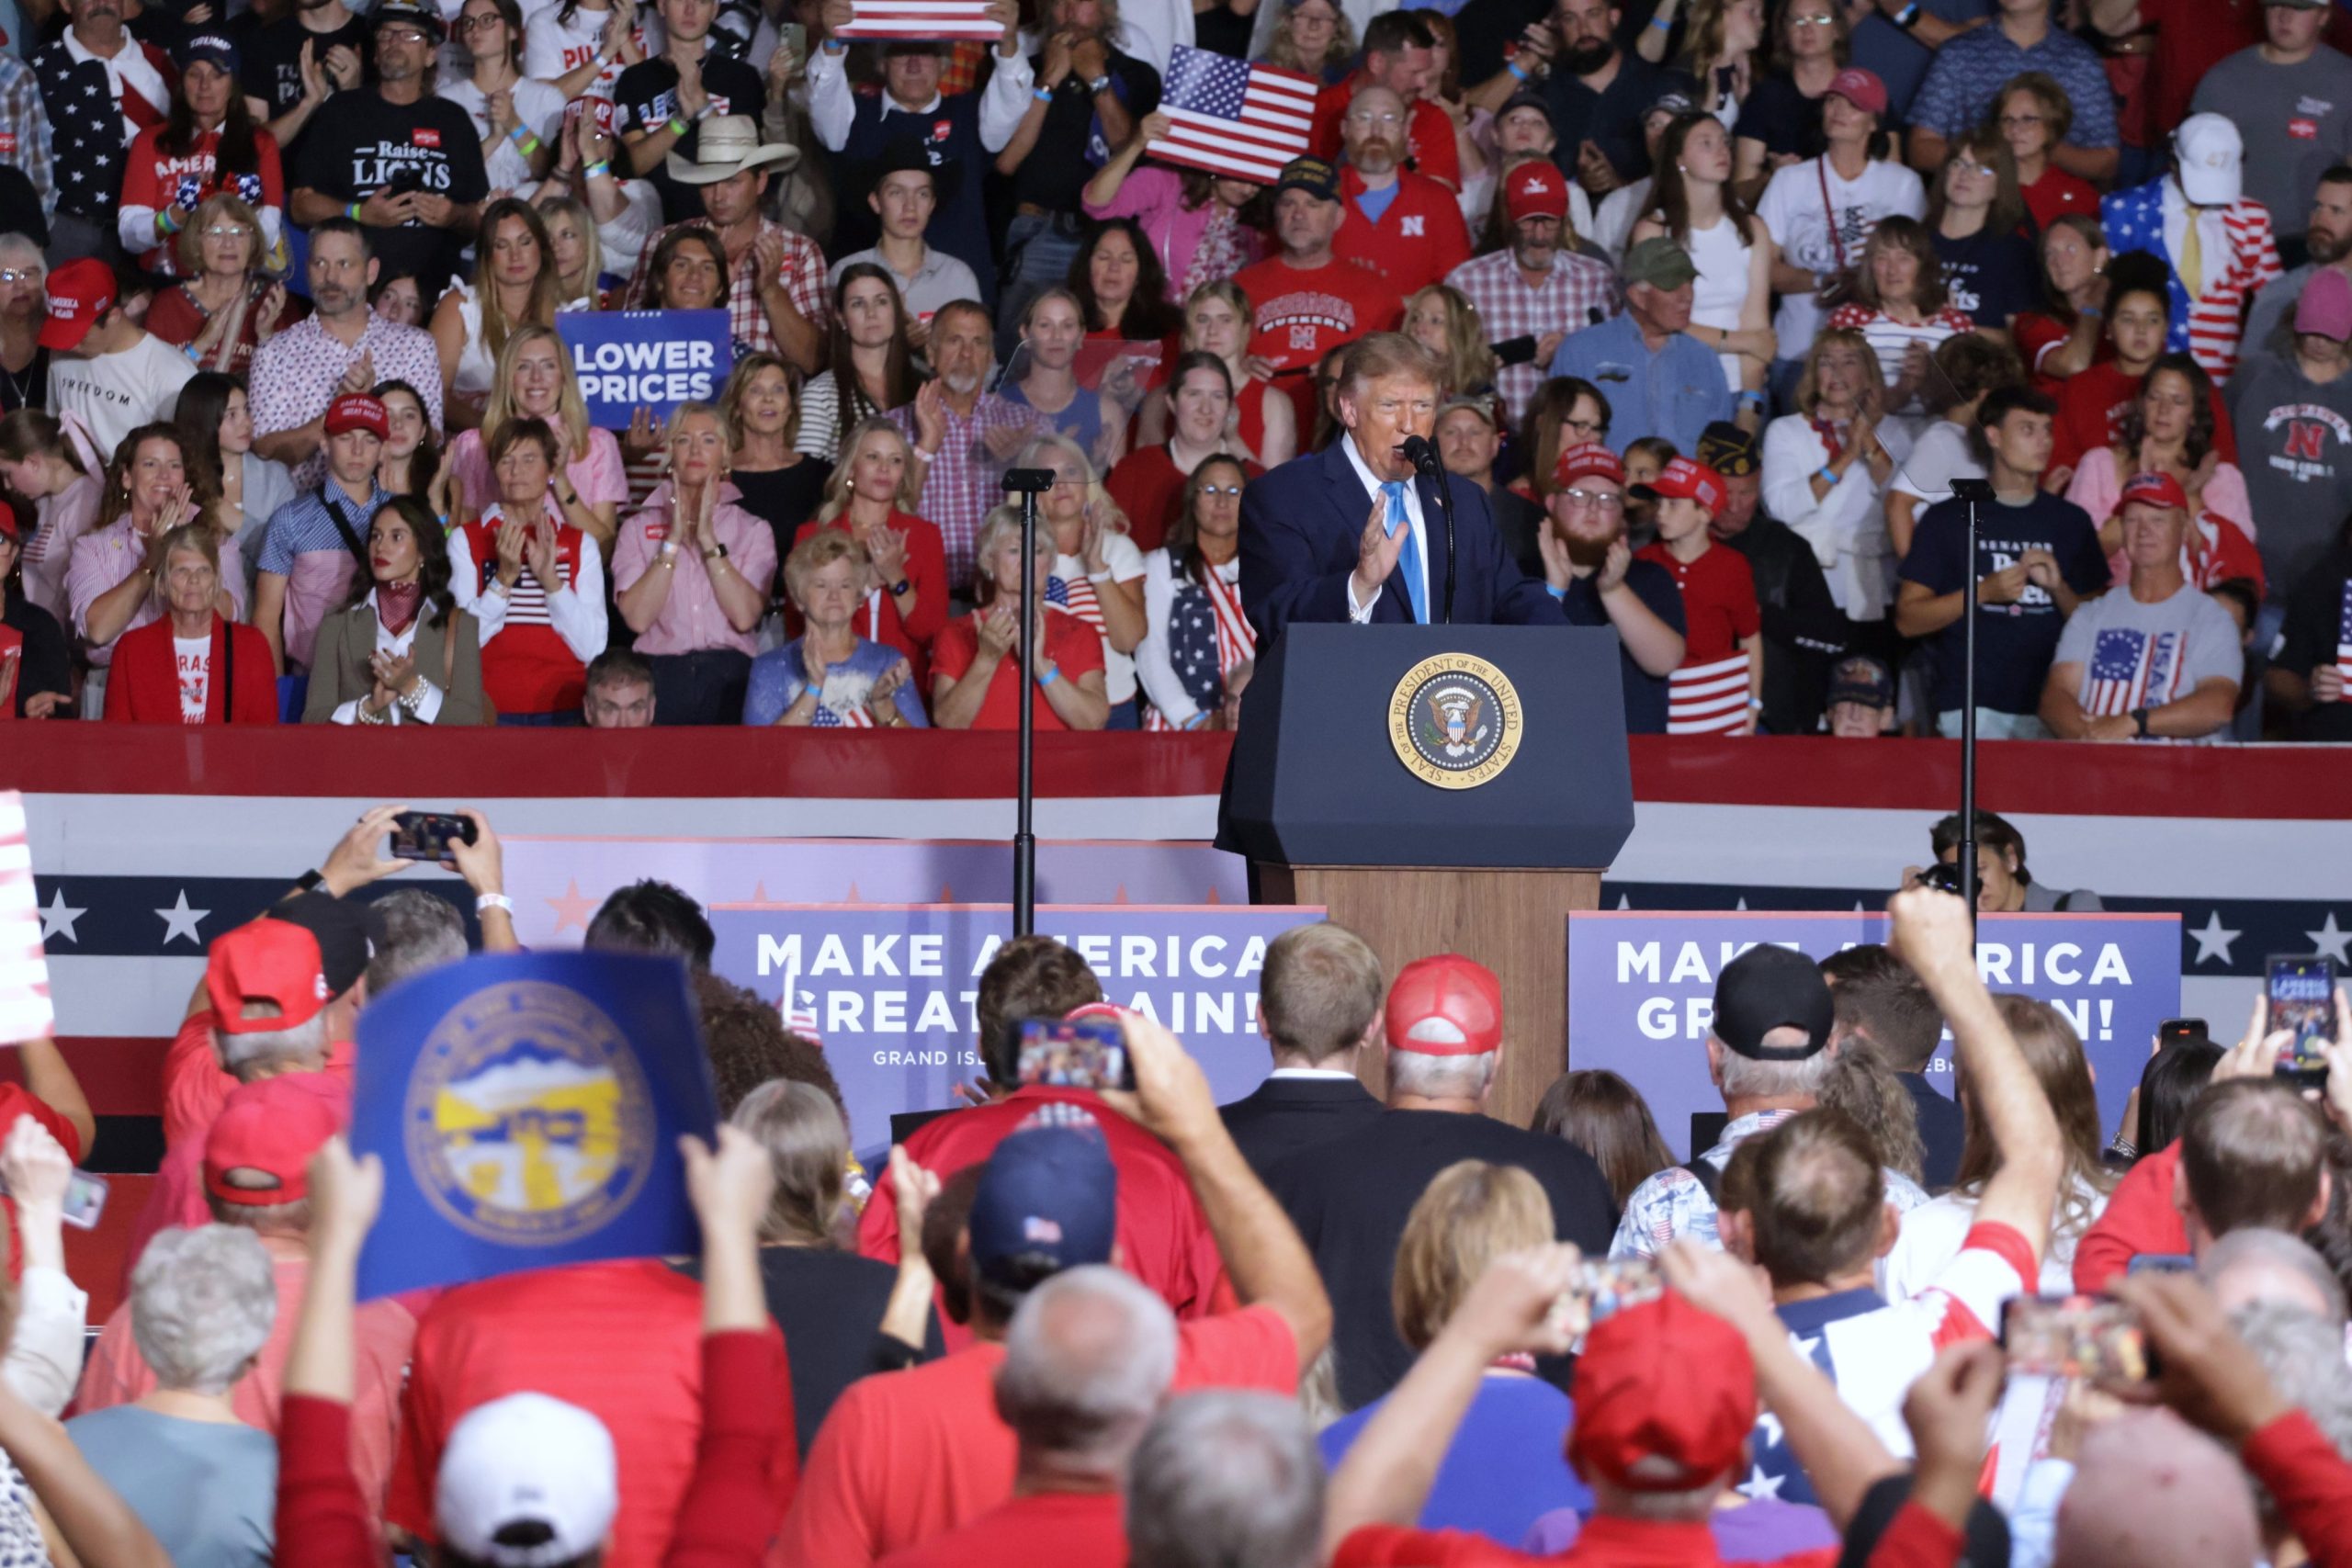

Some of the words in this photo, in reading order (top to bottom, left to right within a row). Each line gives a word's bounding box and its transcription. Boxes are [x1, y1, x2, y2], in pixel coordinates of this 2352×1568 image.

[378, 141, 429, 159] Raise
[154, 153, 217, 179] AMER
[1400, 215, 1425, 237] N
[1289, 325, 1317, 351] N
[574, 340, 715, 372] LOWER
[62, 377, 130, 407] FREEDOM
[578, 371, 714, 404] PRICES
[2284, 420, 2325, 460] N
[1456, 660, 1468, 669] OF
[1472, 663, 1489, 676] THE
[2146, 632, 2175, 689] USA
[1394, 658, 1453, 716] PRESIDENT
[1490, 675, 1518, 730] UNITED
[1395, 721, 1406, 740] THE
[1400, 742, 1411, 754] OF
[1467, 742, 1512, 782] STATES
[1409, 755, 1443, 782] SEAL
[757, 933, 943, 976] MAKE
[970, 933, 1267, 978] AERICA
[1617, 941, 1800, 984] MA
[1102, 991, 1260, 1034] AIN!
[873, 1050, 947, 1066] GRAND
[956, 1050, 987, 1066] ISL
